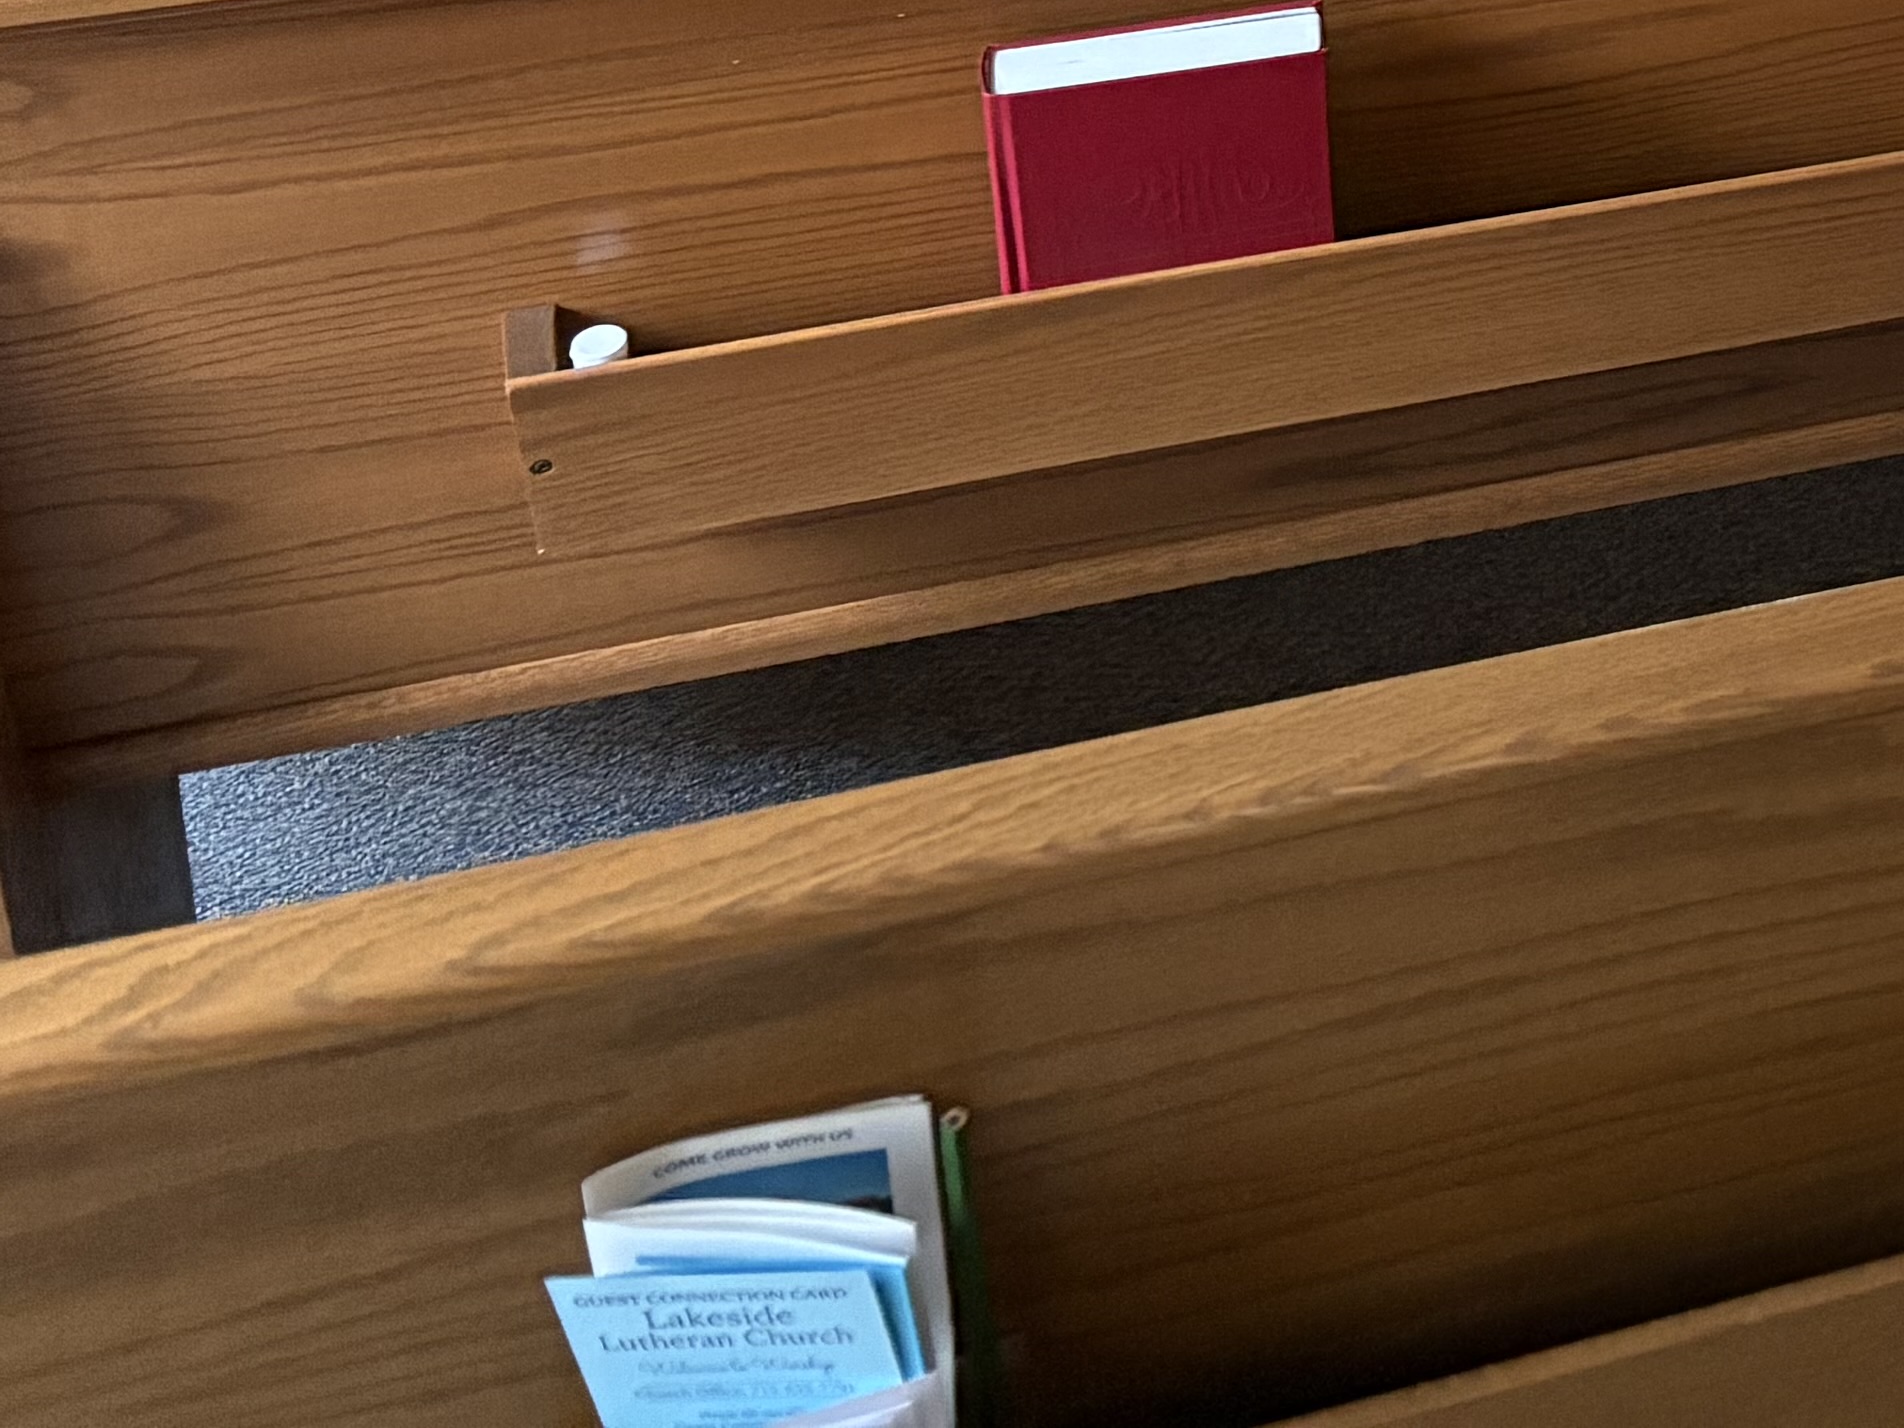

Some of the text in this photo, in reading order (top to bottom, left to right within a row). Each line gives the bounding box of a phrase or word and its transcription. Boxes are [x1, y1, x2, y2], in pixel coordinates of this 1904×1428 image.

[652, 1128, 853, 1179] COME GROW WITH US
[573, 1287, 848, 1308] GUEST CONNECTION CARD
[643, 1305, 794, 1331] Lakeside
[598, 1325, 854, 1353] Lutheran Church
